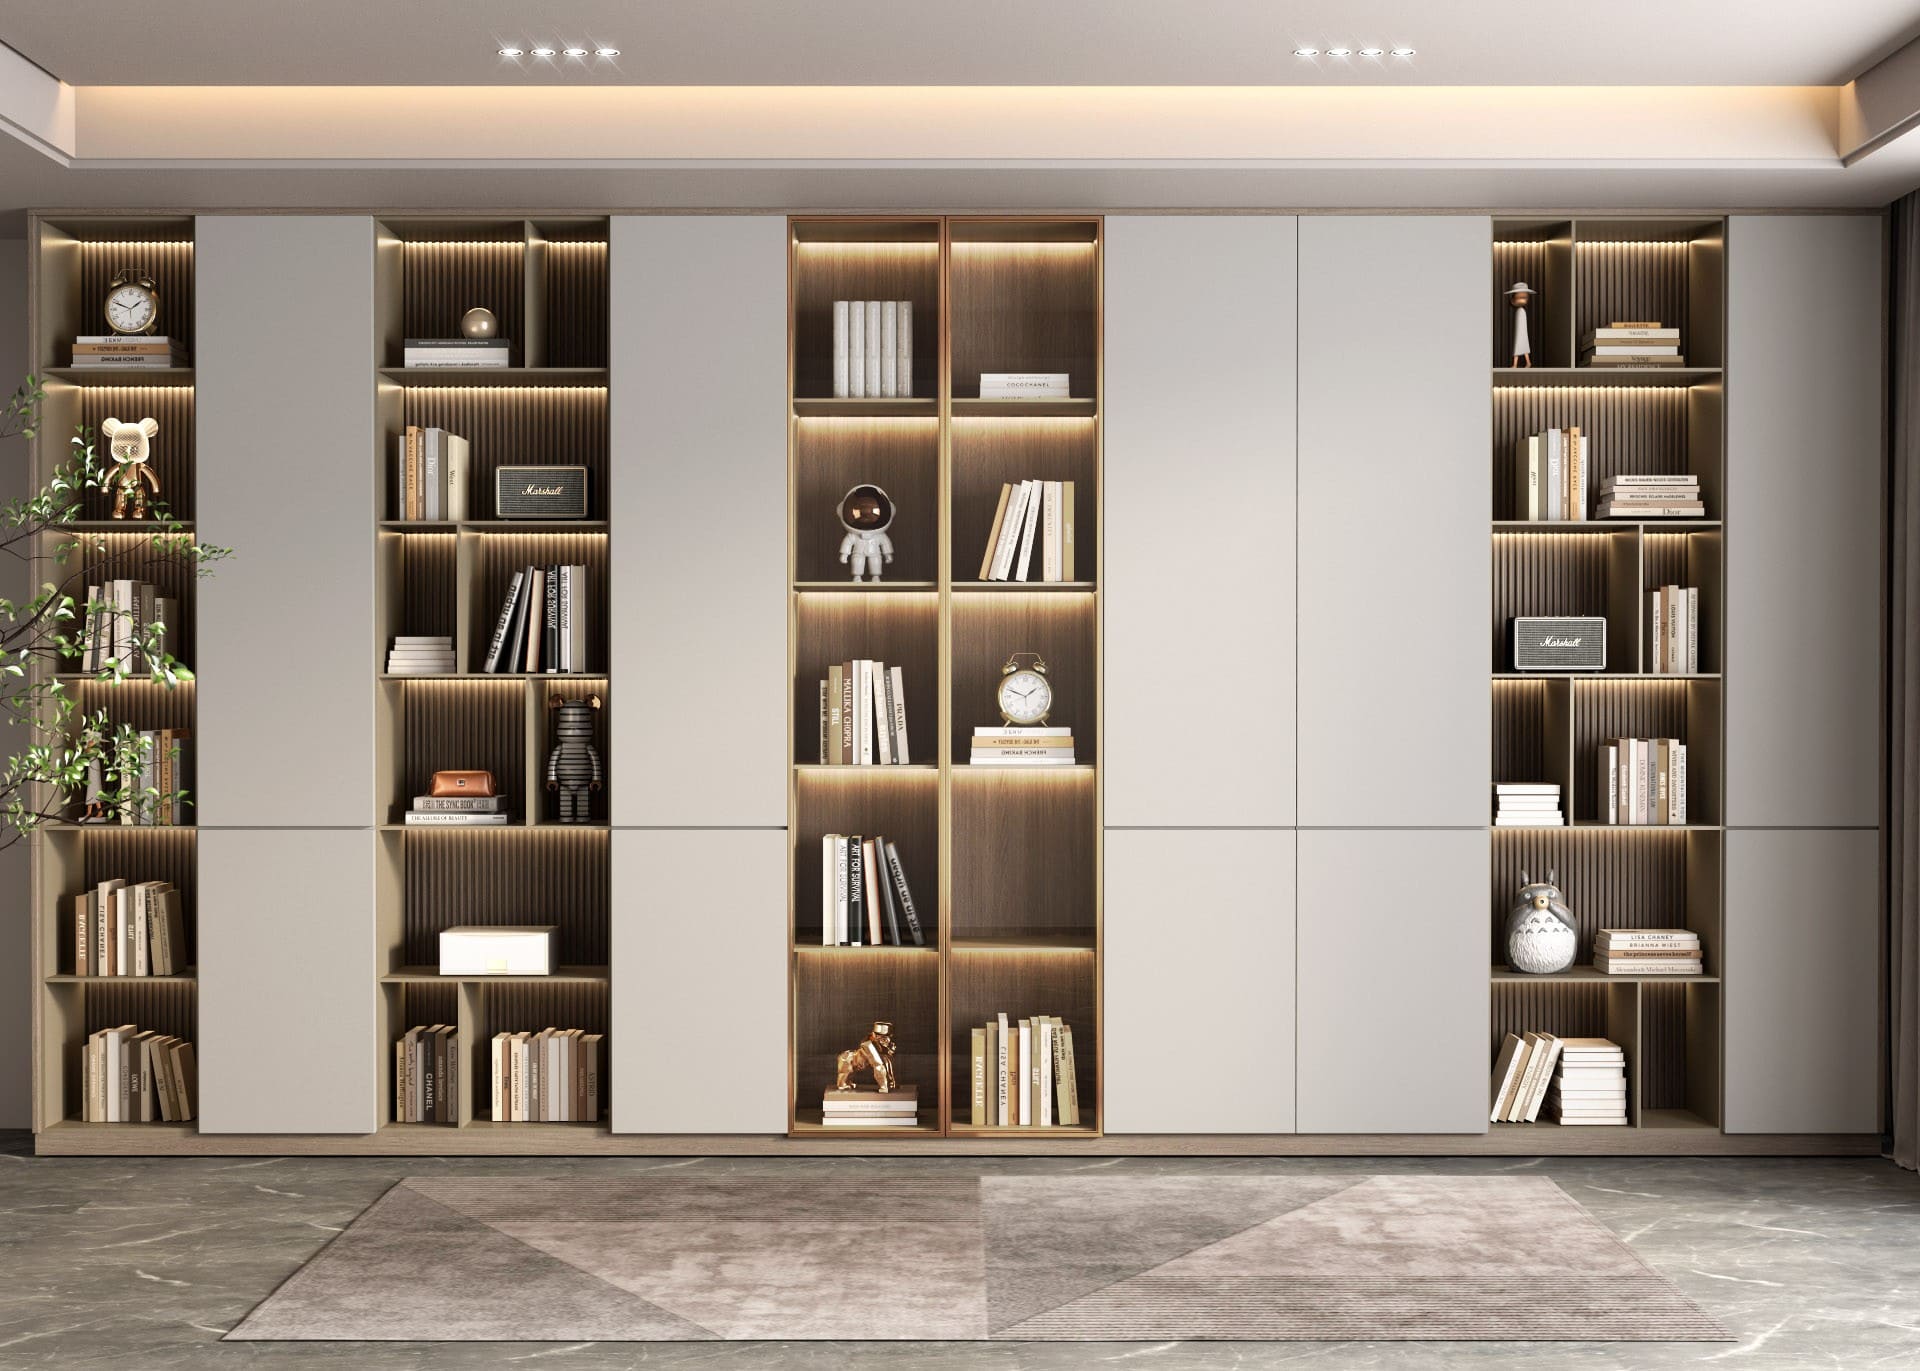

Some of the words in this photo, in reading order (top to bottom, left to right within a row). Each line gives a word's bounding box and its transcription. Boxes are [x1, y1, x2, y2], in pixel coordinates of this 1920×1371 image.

[521, 483, 563, 495] Marshall
[1540, 636, 1582, 647] Marshall
[436, 800, 445, 809] THE
[852, 844, 860, 856] ART
[852, 858, 860, 871] FOR
[891, 858, 905, 888] urban
[852, 873, 860, 902] SURVIVAL
[901, 891, 910, 903] an
